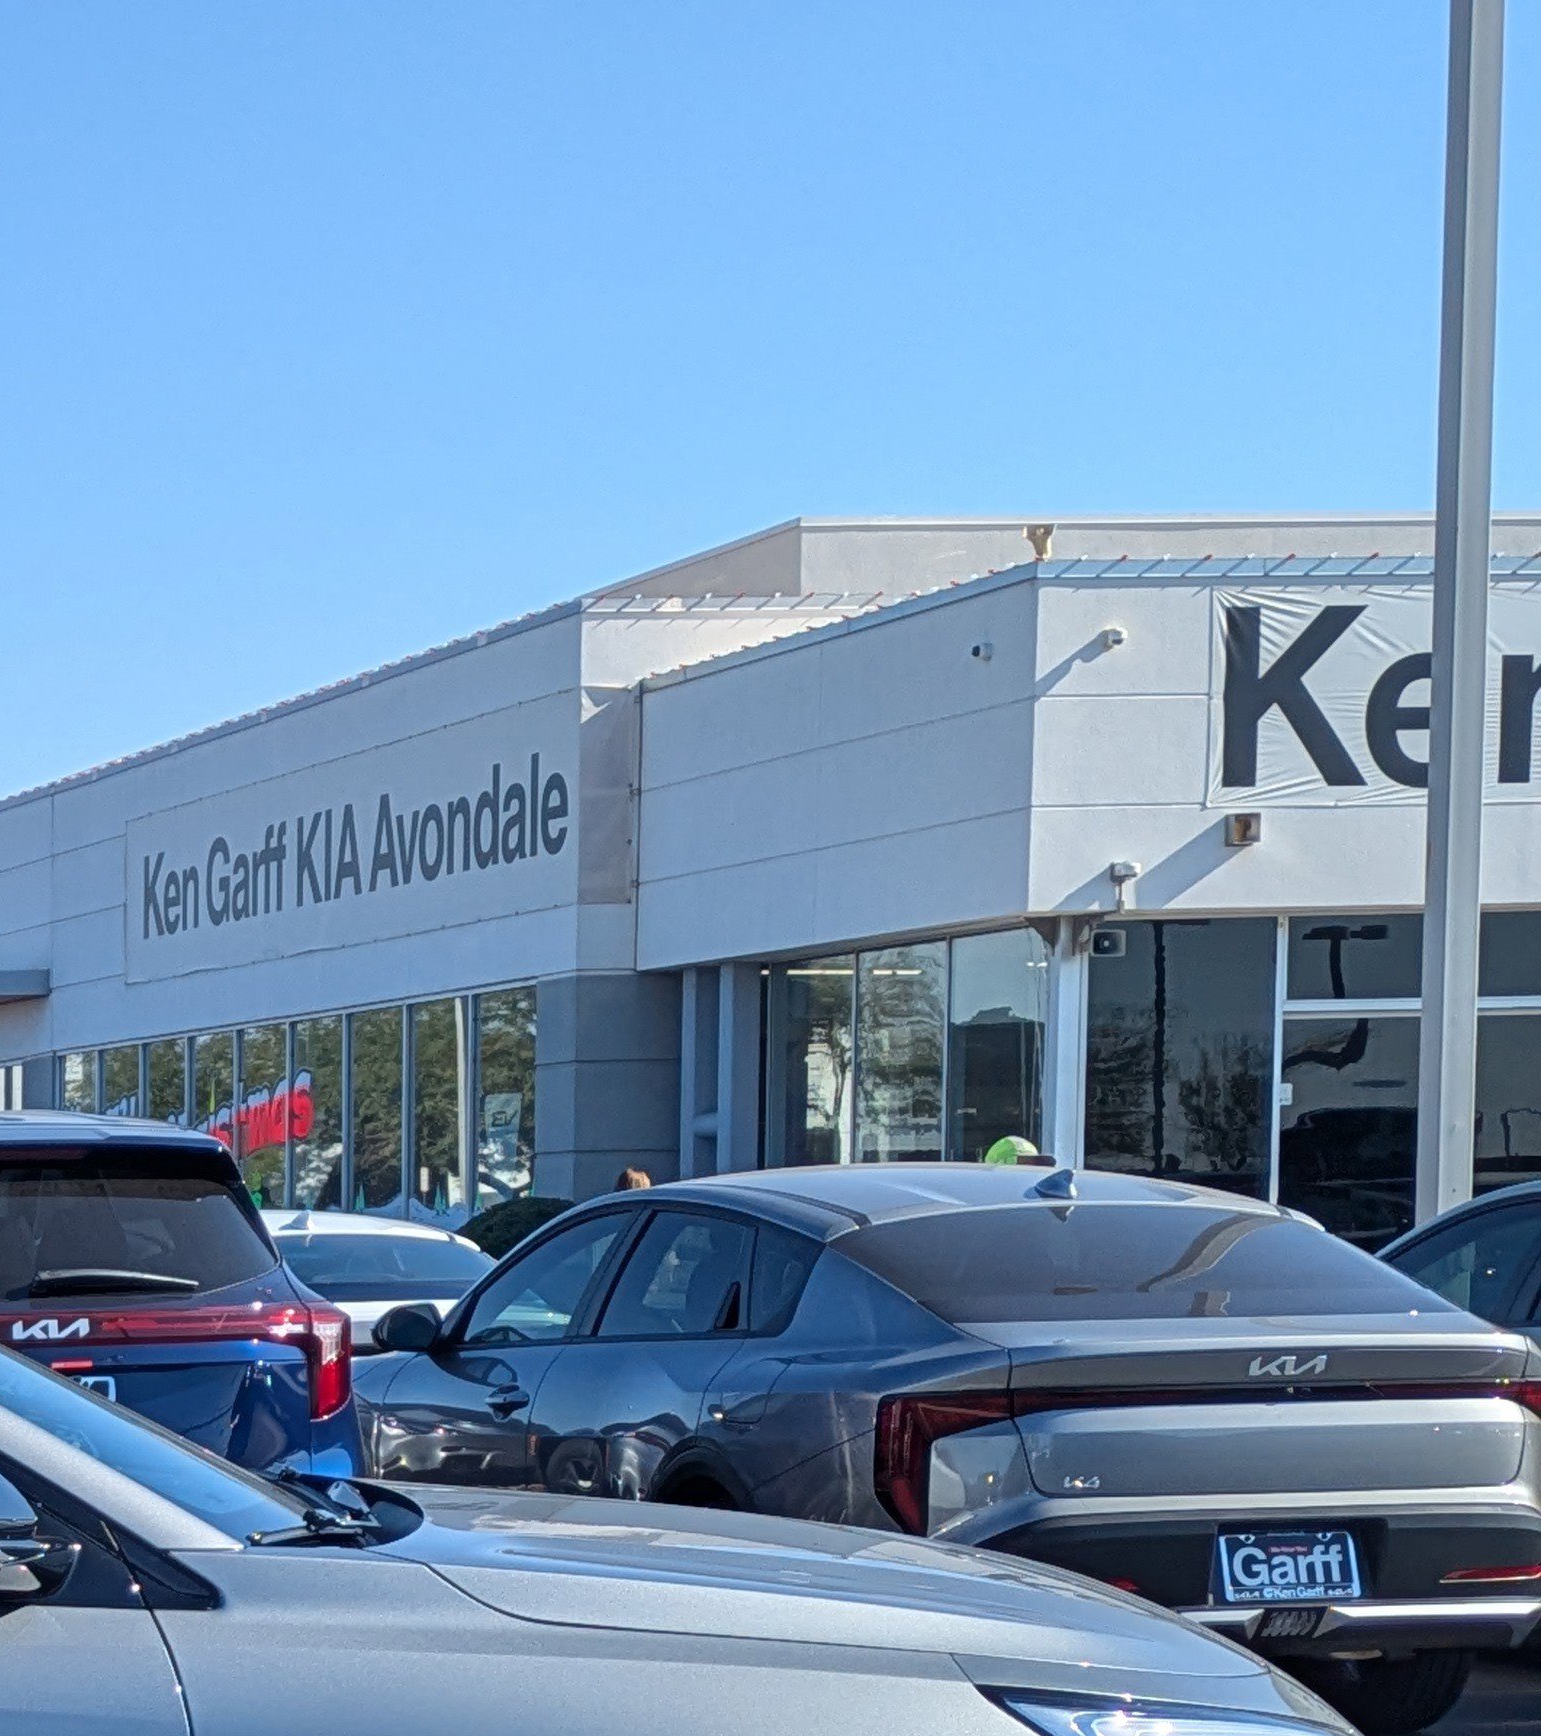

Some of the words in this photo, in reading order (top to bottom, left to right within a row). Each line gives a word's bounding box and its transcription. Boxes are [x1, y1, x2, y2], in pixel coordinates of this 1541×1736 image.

[143, 851, 199, 939] Ken
[206, 820, 287, 927] Garff
[296, 803, 362, 906] KIA
[368, 752, 569, 893] Avondale
[12, 1318, 90, 1340] KIA
[1248, 1355, 1327, 1376] KIA
[1233, 1544, 1342, 1586] Garff
